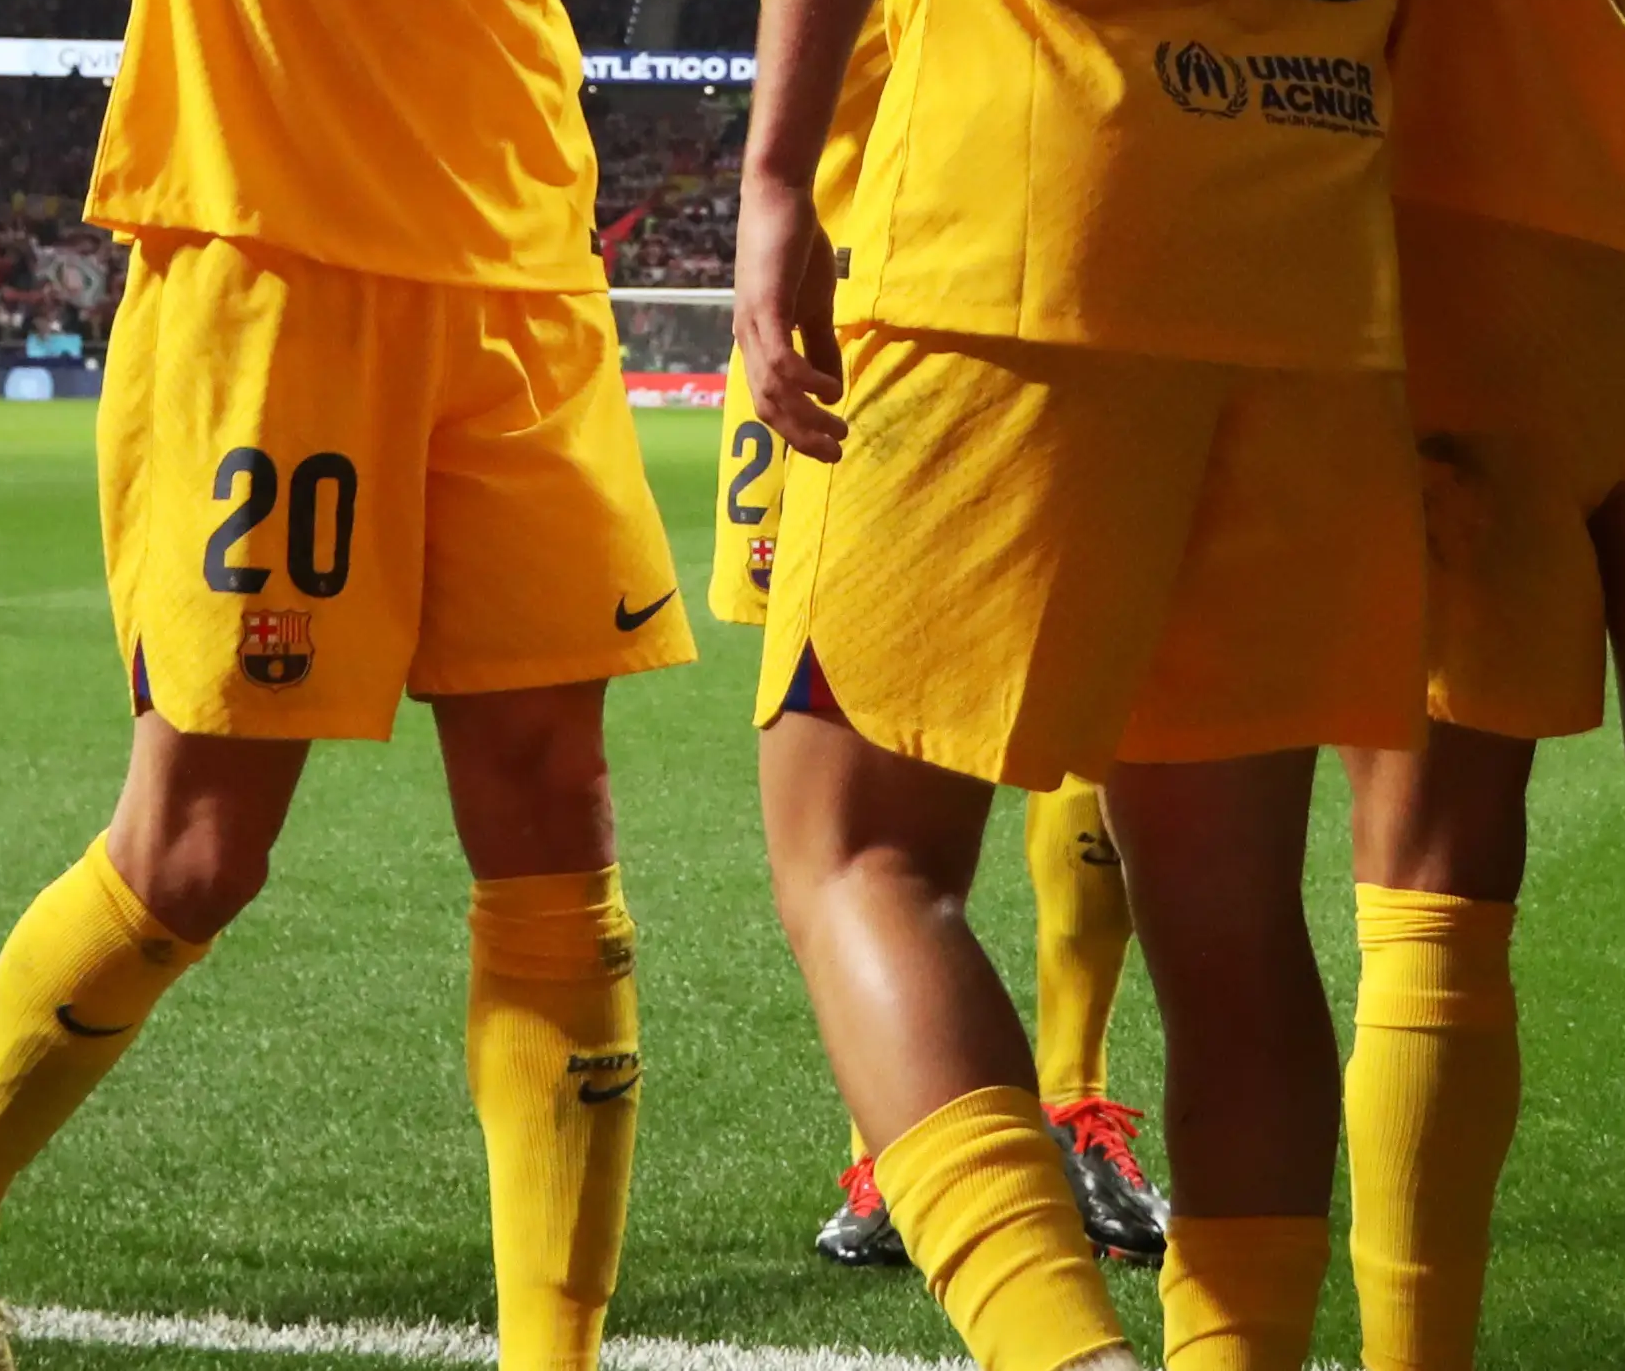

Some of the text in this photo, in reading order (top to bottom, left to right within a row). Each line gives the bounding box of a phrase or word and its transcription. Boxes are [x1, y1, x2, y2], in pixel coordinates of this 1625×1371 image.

[730, 57, 757, 80] D
[1246, 56, 1372, 97] UNHCR
[1261, 83, 1380, 127] ACNUR
[728, 421, 787, 524] 2
[203, 446, 358, 599] 20
